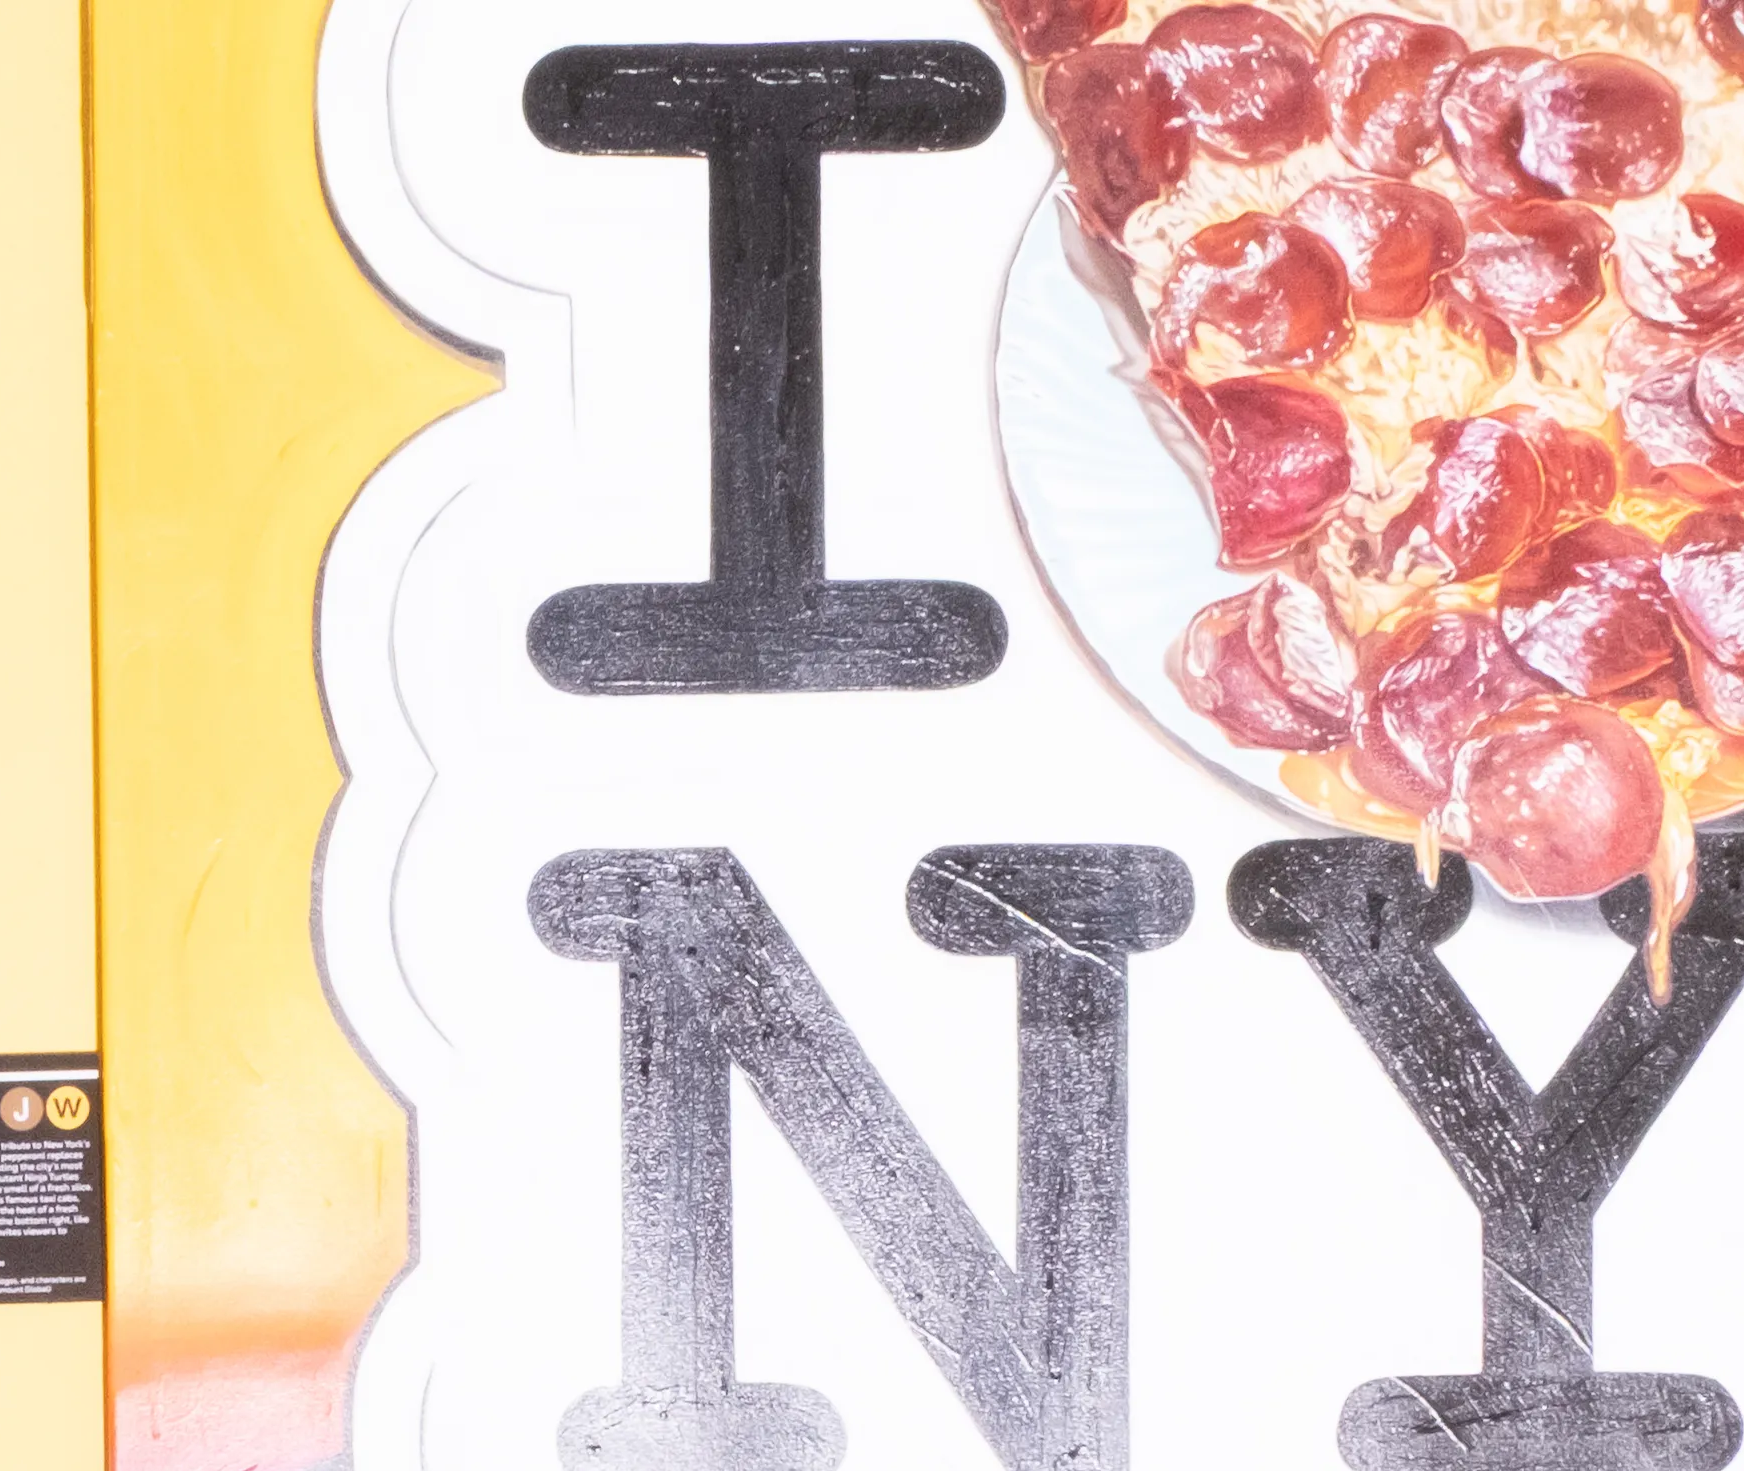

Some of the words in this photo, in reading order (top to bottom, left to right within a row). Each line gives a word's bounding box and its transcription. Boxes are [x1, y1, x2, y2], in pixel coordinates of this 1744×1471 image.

[523, 38, 1005, 696] I
[13, 1096, 30, 1122] J
[53, 1097, 82, 1118] W
